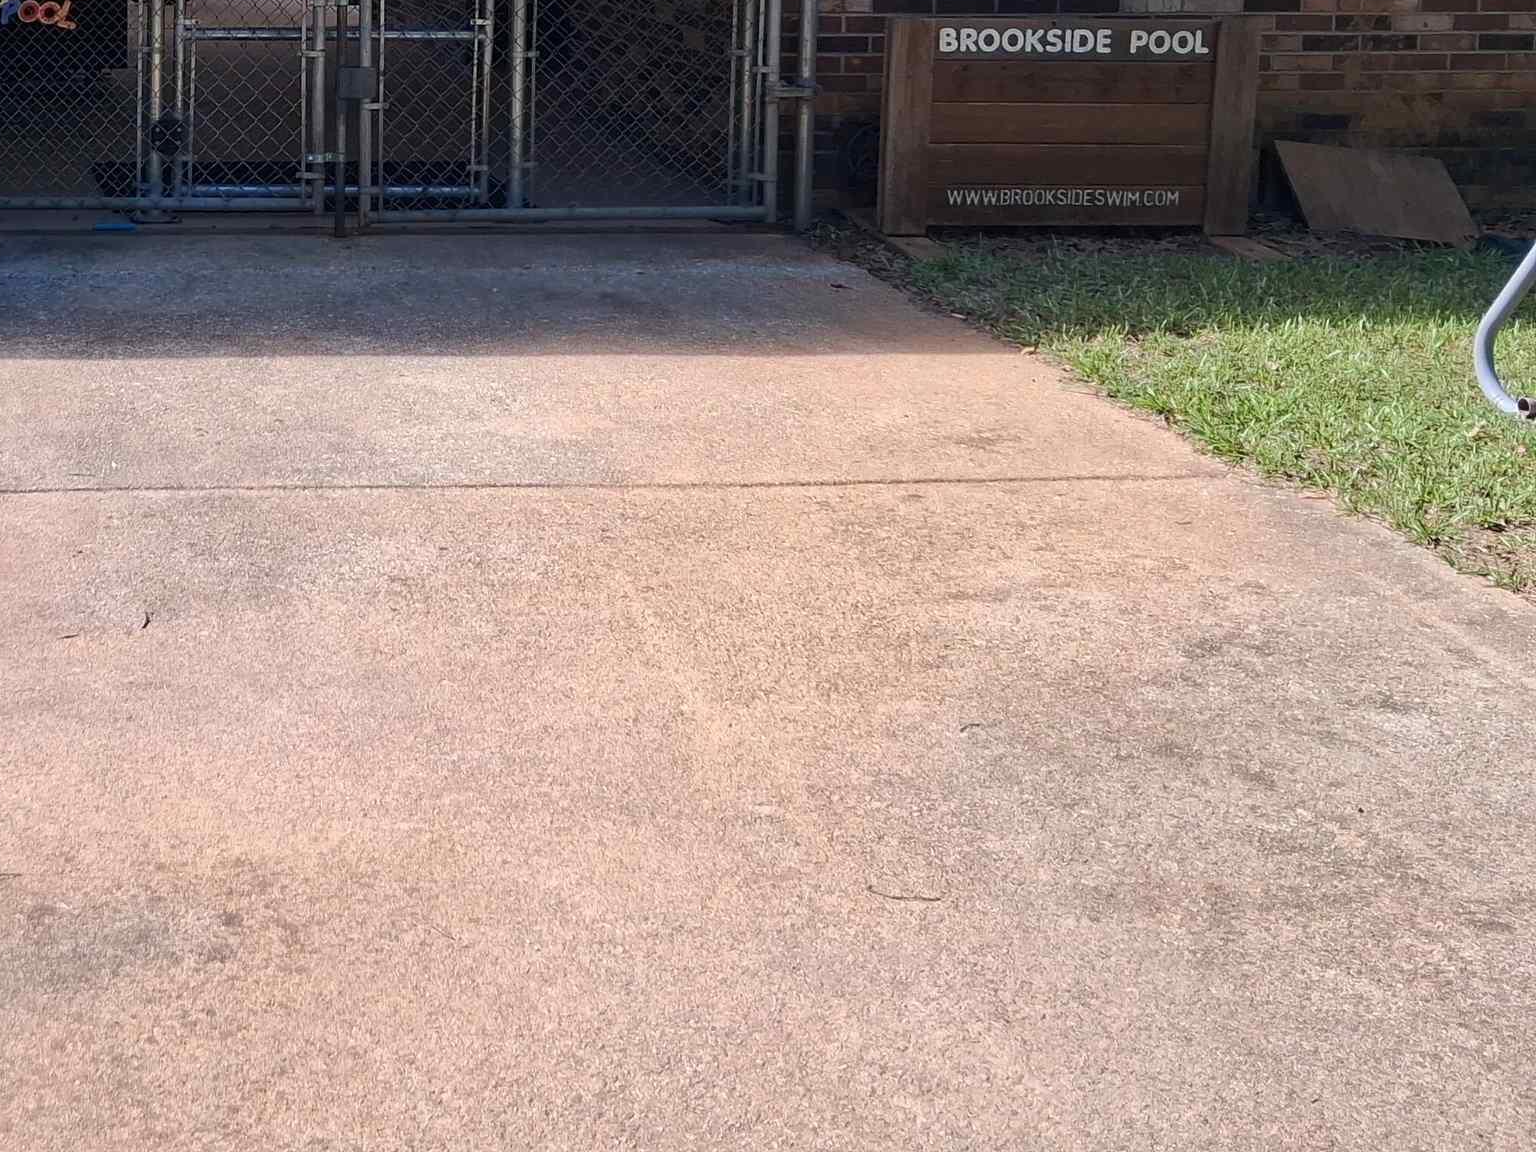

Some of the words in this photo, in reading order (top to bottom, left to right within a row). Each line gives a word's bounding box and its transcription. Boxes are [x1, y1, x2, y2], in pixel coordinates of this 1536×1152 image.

[939, 27, 1112, 54] BROOKSIDE
[1130, 30, 1209, 54] POOL
[947, 189, 1180, 207] WWW.BROOKSIDESWIM.COM
